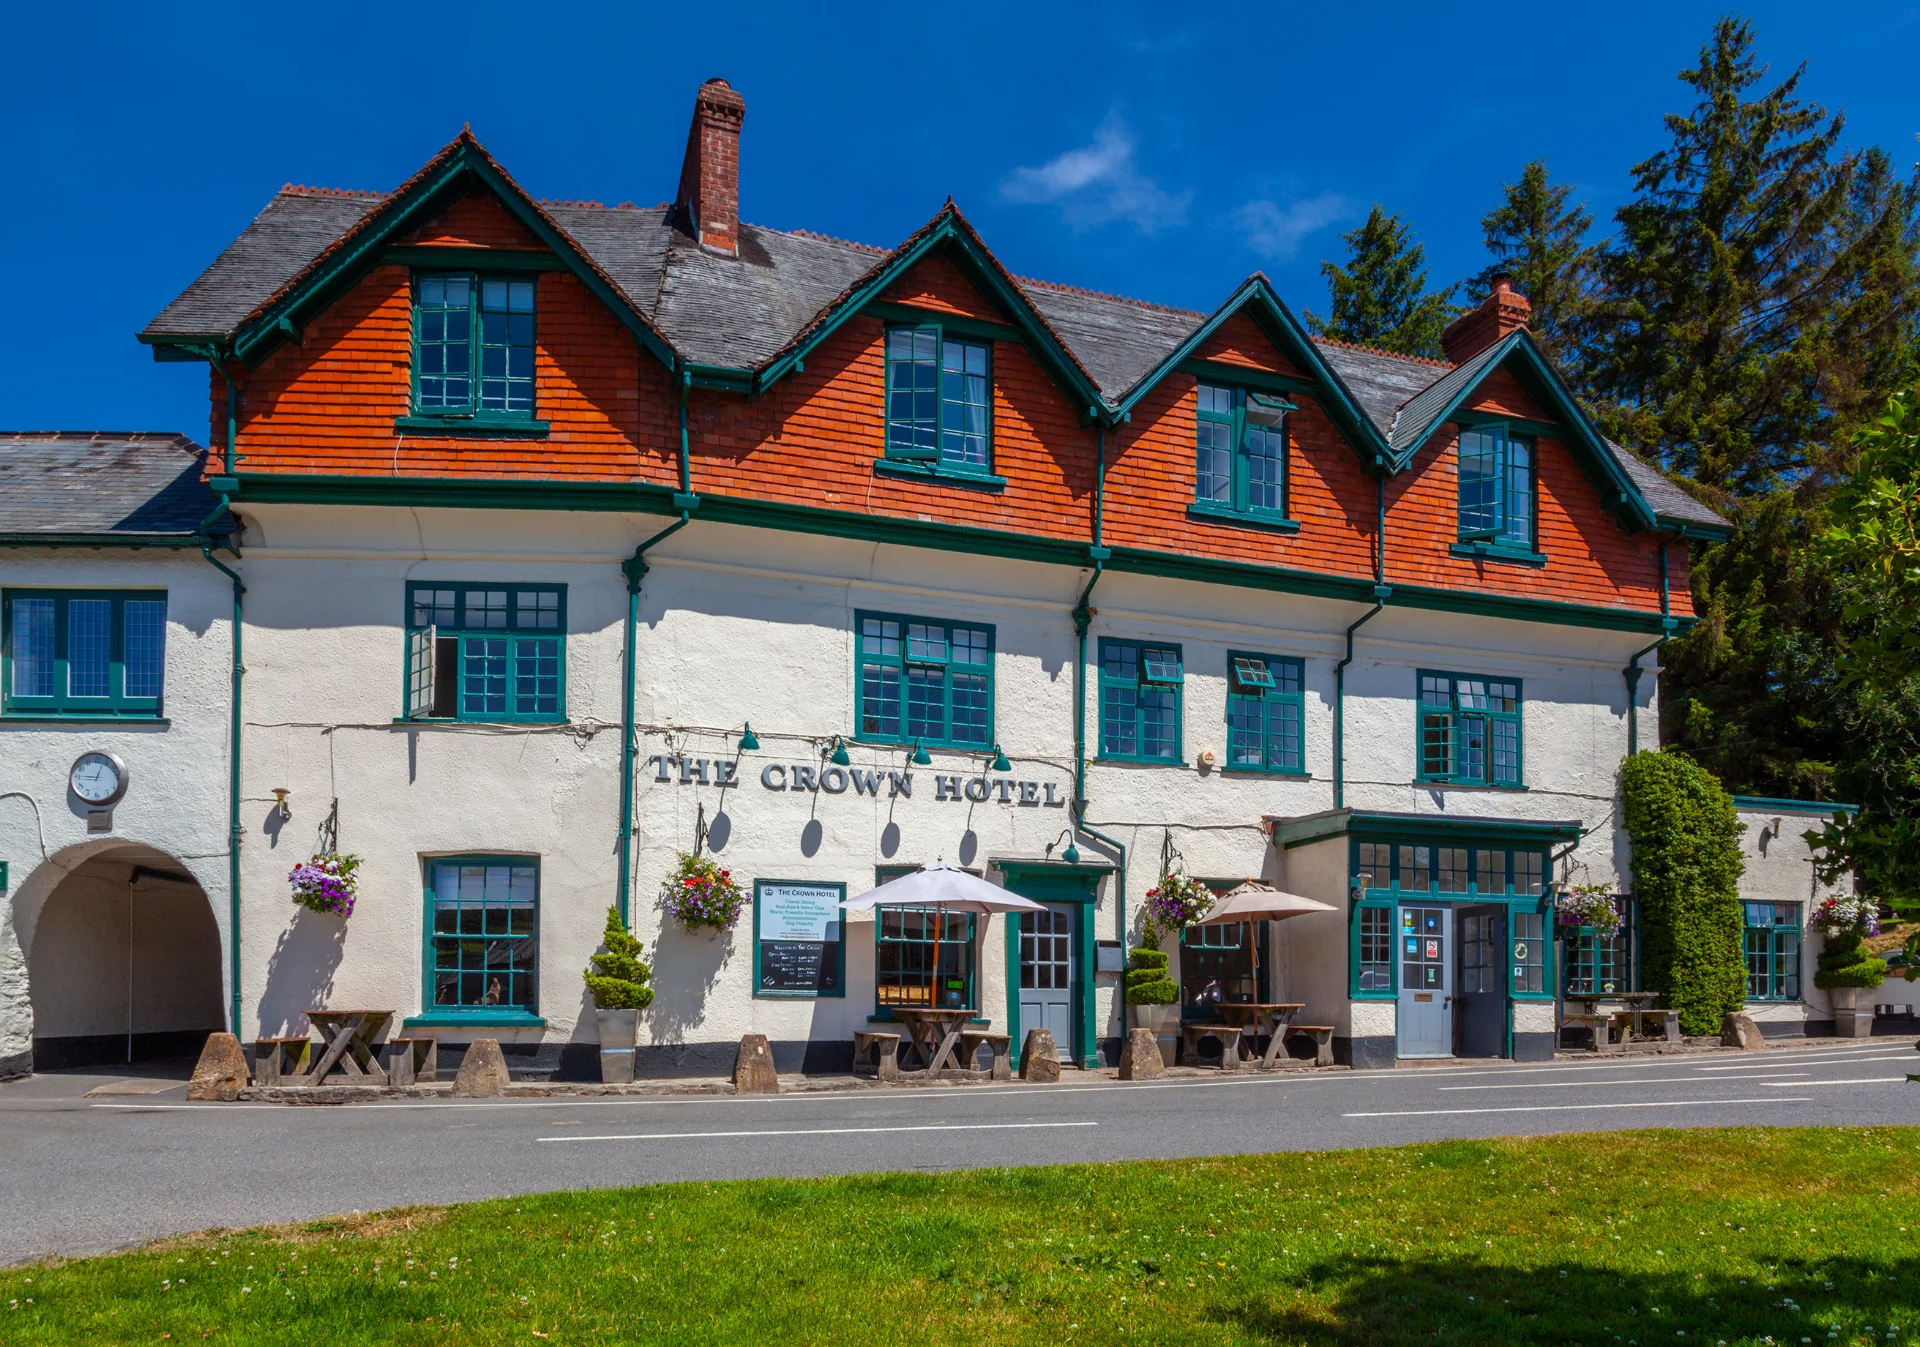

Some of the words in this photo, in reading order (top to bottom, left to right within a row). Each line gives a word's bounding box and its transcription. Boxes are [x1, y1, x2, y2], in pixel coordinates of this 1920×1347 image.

[650, 754, 739, 788] THE
[761, 762, 913, 798] CROWN
[935, 775, 1065, 808] HOTEL
[792, 889, 815, 897] CROWN
